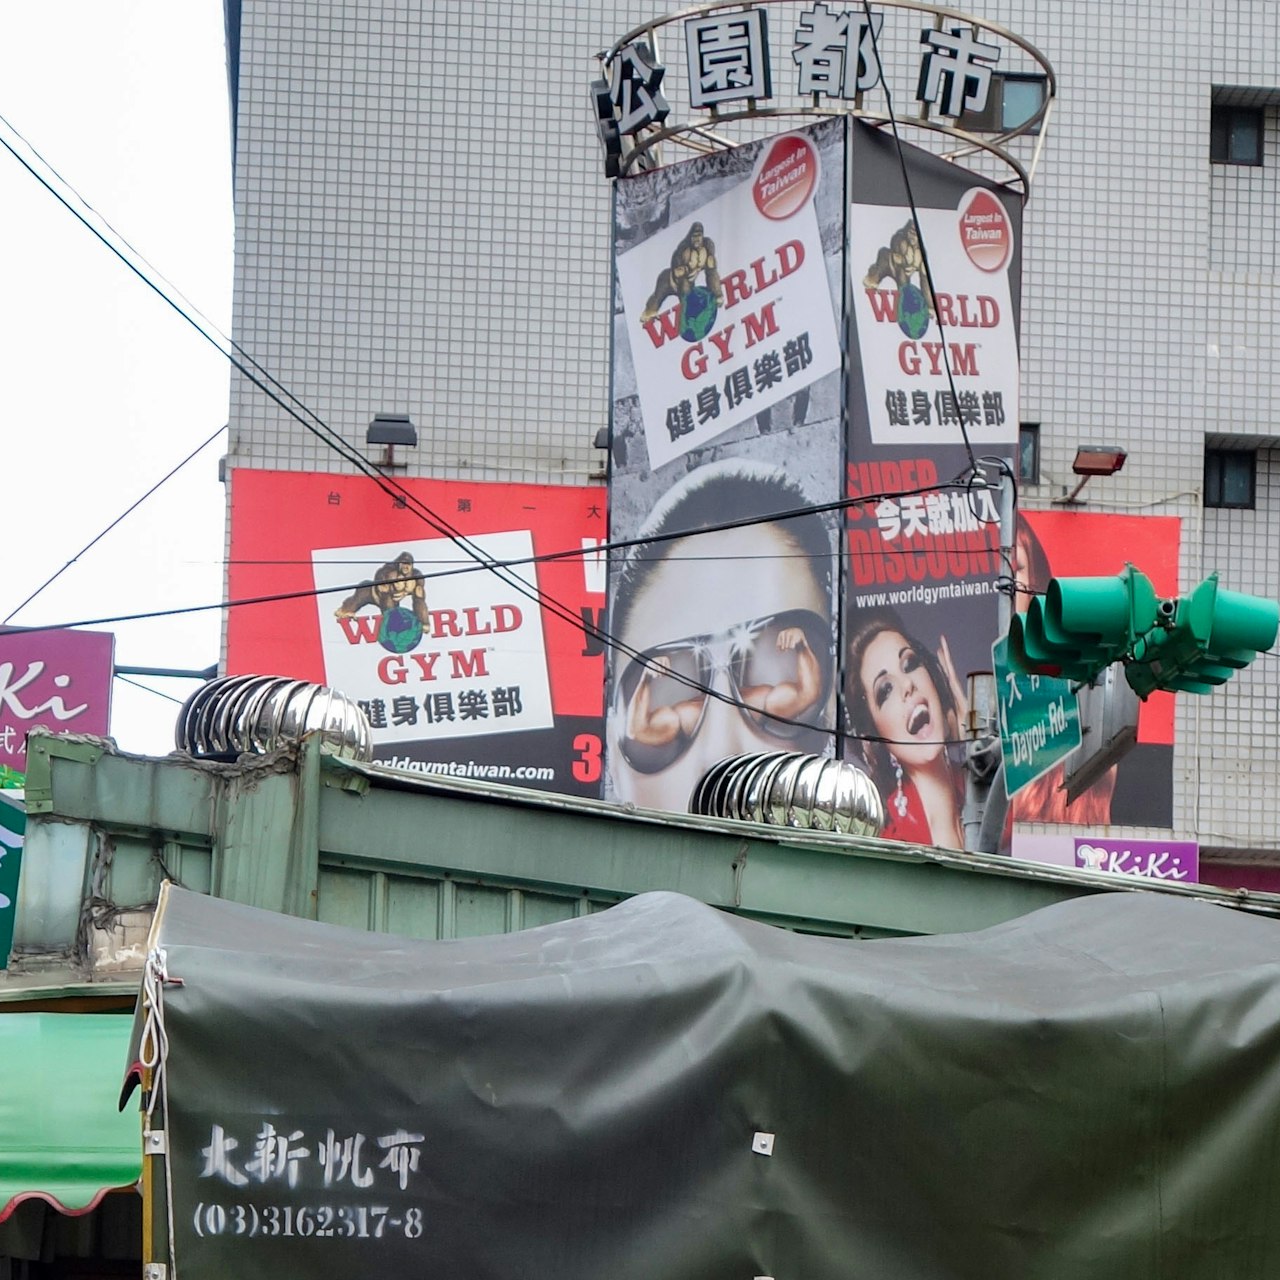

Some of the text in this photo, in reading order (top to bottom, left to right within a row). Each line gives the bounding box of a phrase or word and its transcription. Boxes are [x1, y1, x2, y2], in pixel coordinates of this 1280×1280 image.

[608, 4, 1002, 136] 公園都市
[760, 162, 807, 199] Taiwan
[965, 227, 1003, 240] Taiwan
[681, 299, 782, 381] GYM
[898, 340, 980, 377] GYM
[665, 331, 814, 443] 健身俱樂部
[884, 389, 1006, 427] 健身俱樂部
[875, 489, 1002, 541] 今天就加入
[856, 580, 1001, 609] www.worldgymtaiwan.c
[377, 647, 490, 686] GYM
[1011, 695, 1069, 767] Dayou Rd.
[200, 1121, 426, 1191] 大新帆布
[192, 1202, 423, 1239] (03)3162317-8
